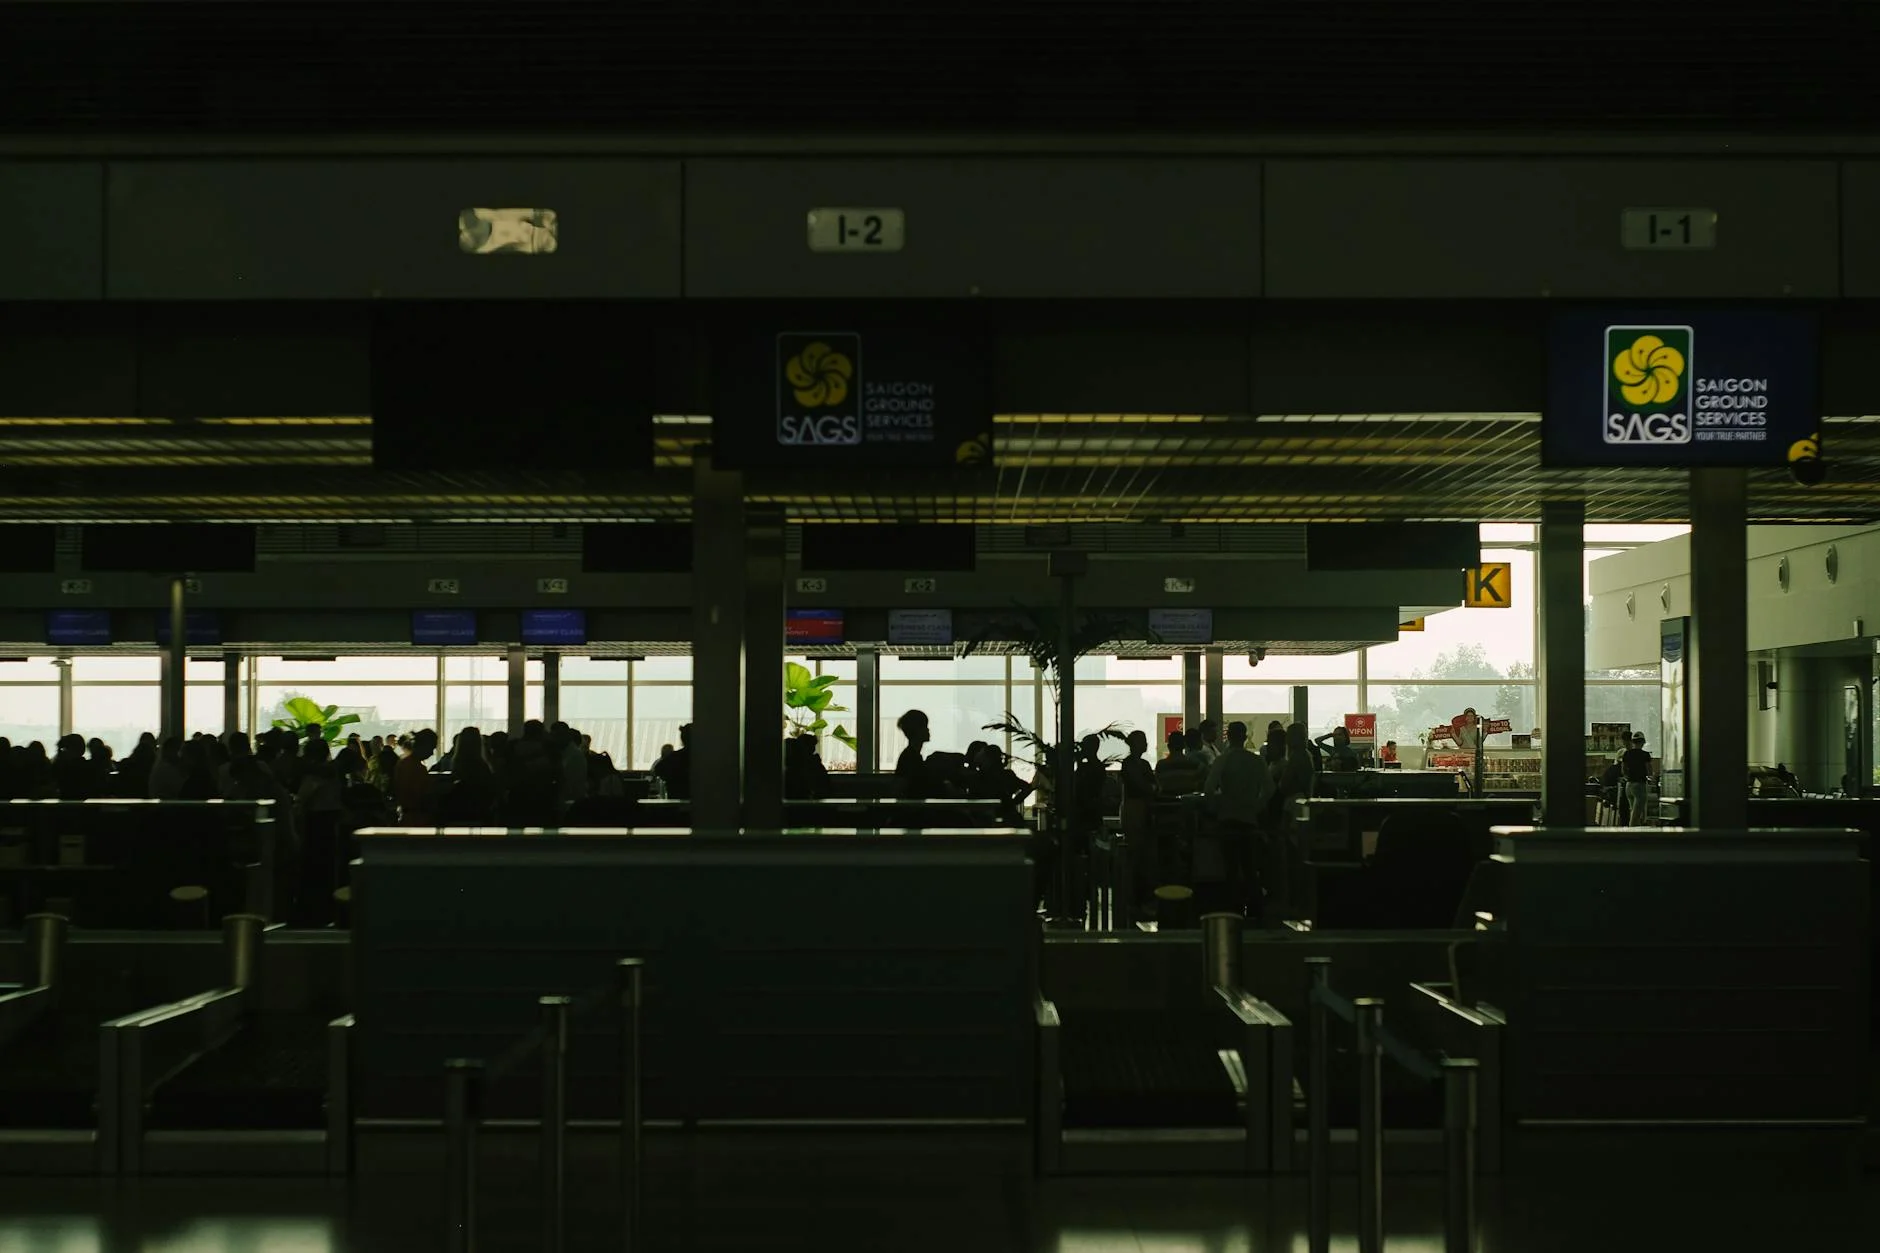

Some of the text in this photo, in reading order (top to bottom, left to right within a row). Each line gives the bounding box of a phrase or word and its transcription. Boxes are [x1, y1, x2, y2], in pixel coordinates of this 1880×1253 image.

[838, 214, 882, 244] I-2
[1650, 214, 1690, 244] I-1
[865, 381, 934, 396] SAIGON
[1696, 378, 1767, 393] SAIGON
[865, 397, 935, 412] GROUND
[1695, 395, 1768, 410] GROUND
[865, 413, 934, 428] SERVICES
[1696, 411, 1767, 426] SERVICES
[782, 415, 857, 443] SAGS
[1608, 412, 1687, 441] SAGS
[802, 580, 823, 590] K-3
[911, 580, 931, 591] K-2
[1474, 568, 1503, 602] K
[1348, 728, 1373, 736] VIFON
